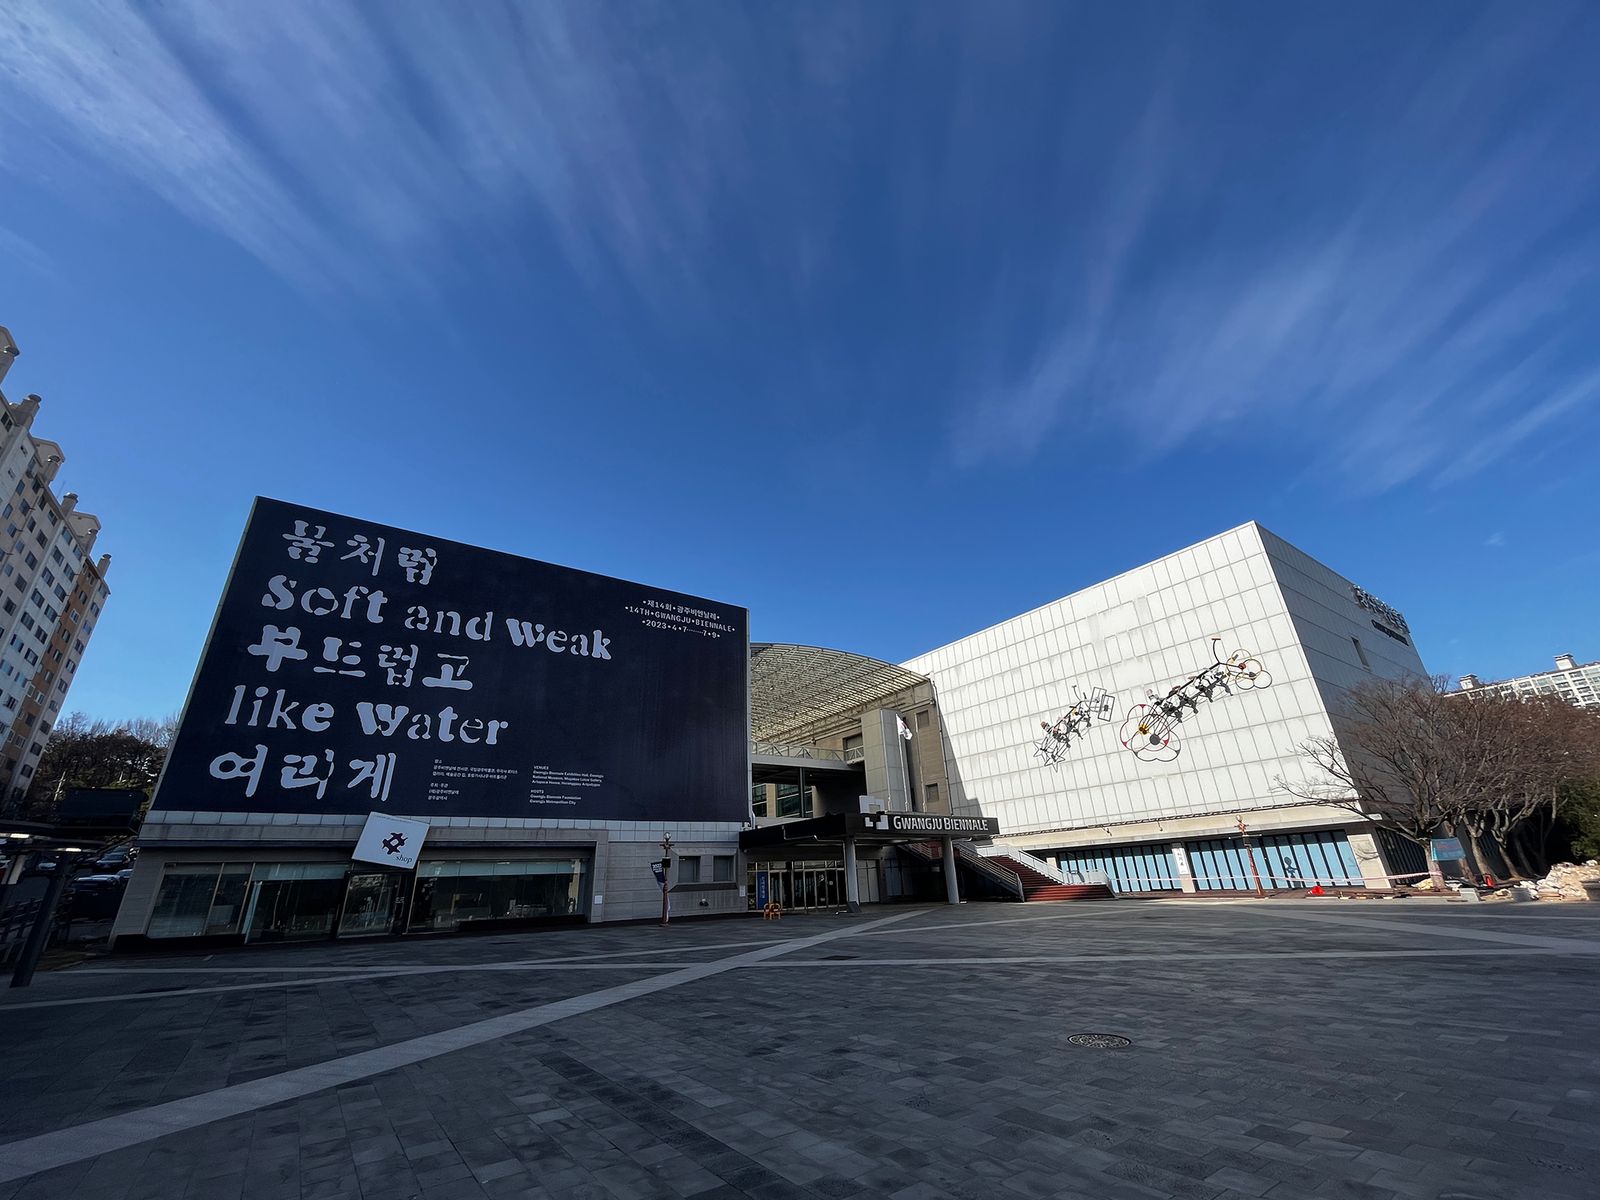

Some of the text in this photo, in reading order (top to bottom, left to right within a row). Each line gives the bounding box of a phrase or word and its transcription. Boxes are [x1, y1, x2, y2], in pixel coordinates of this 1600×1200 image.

[405, 605, 494, 642] and
[247, 624, 474, 691] 부드럽고
[224, 684, 335, 732] like
[208, 743, 397, 801] 여리게
[893, 815, 989, 831] GWANGJU BIENNALE
